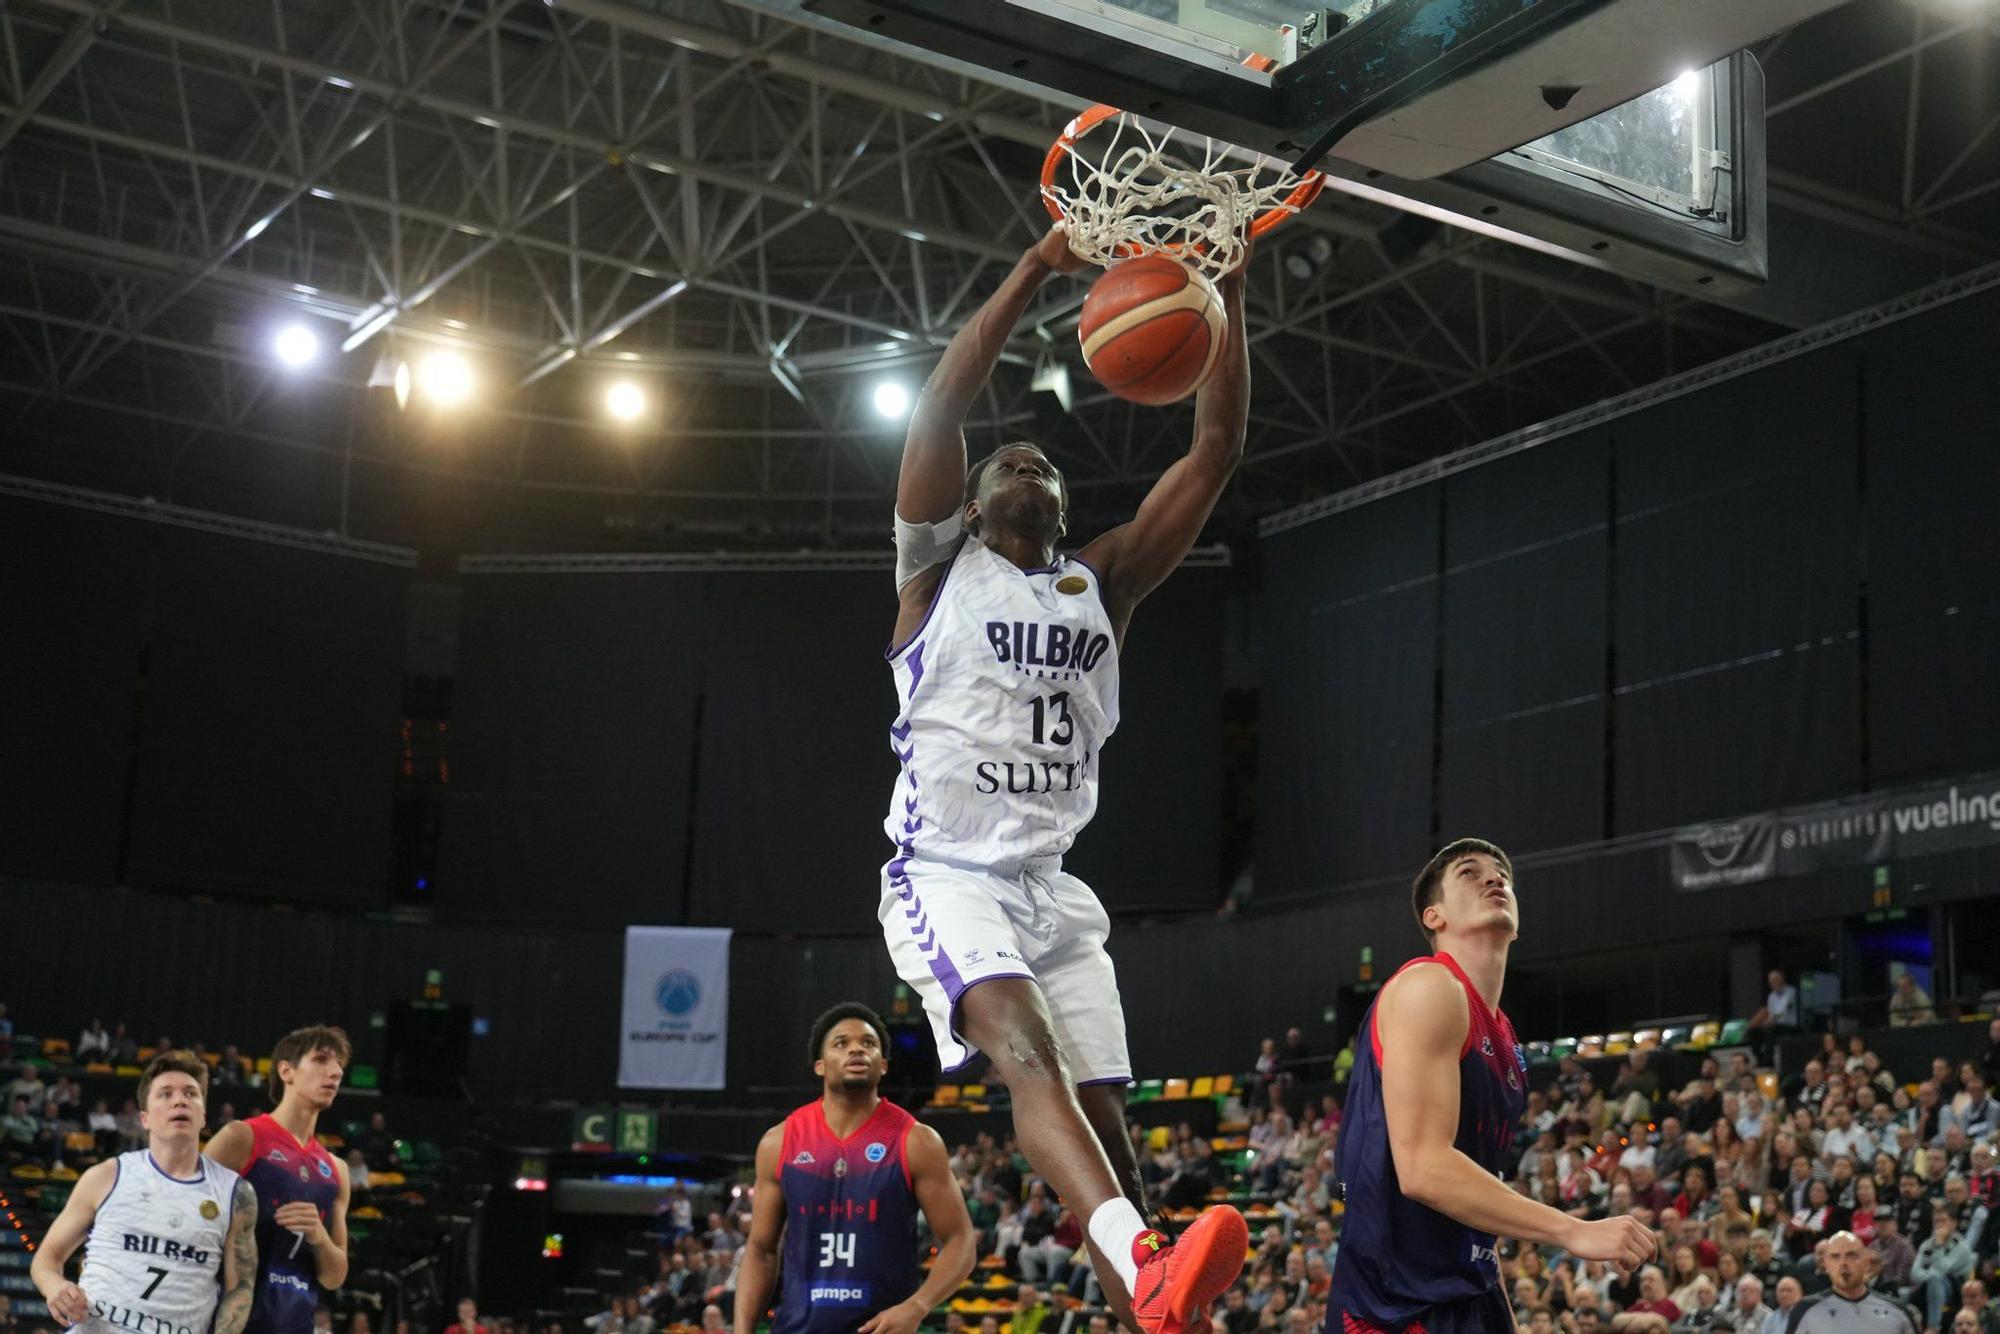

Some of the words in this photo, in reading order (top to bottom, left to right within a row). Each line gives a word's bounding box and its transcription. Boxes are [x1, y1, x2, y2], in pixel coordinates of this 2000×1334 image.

[986, 621, 1110, 673] BILBAO
[1027, 691, 1074, 745] 13
[582, 1114, 606, 1143] C
[819, 1232, 856, 1268] 34
[139, 1266, 169, 1300] 7
